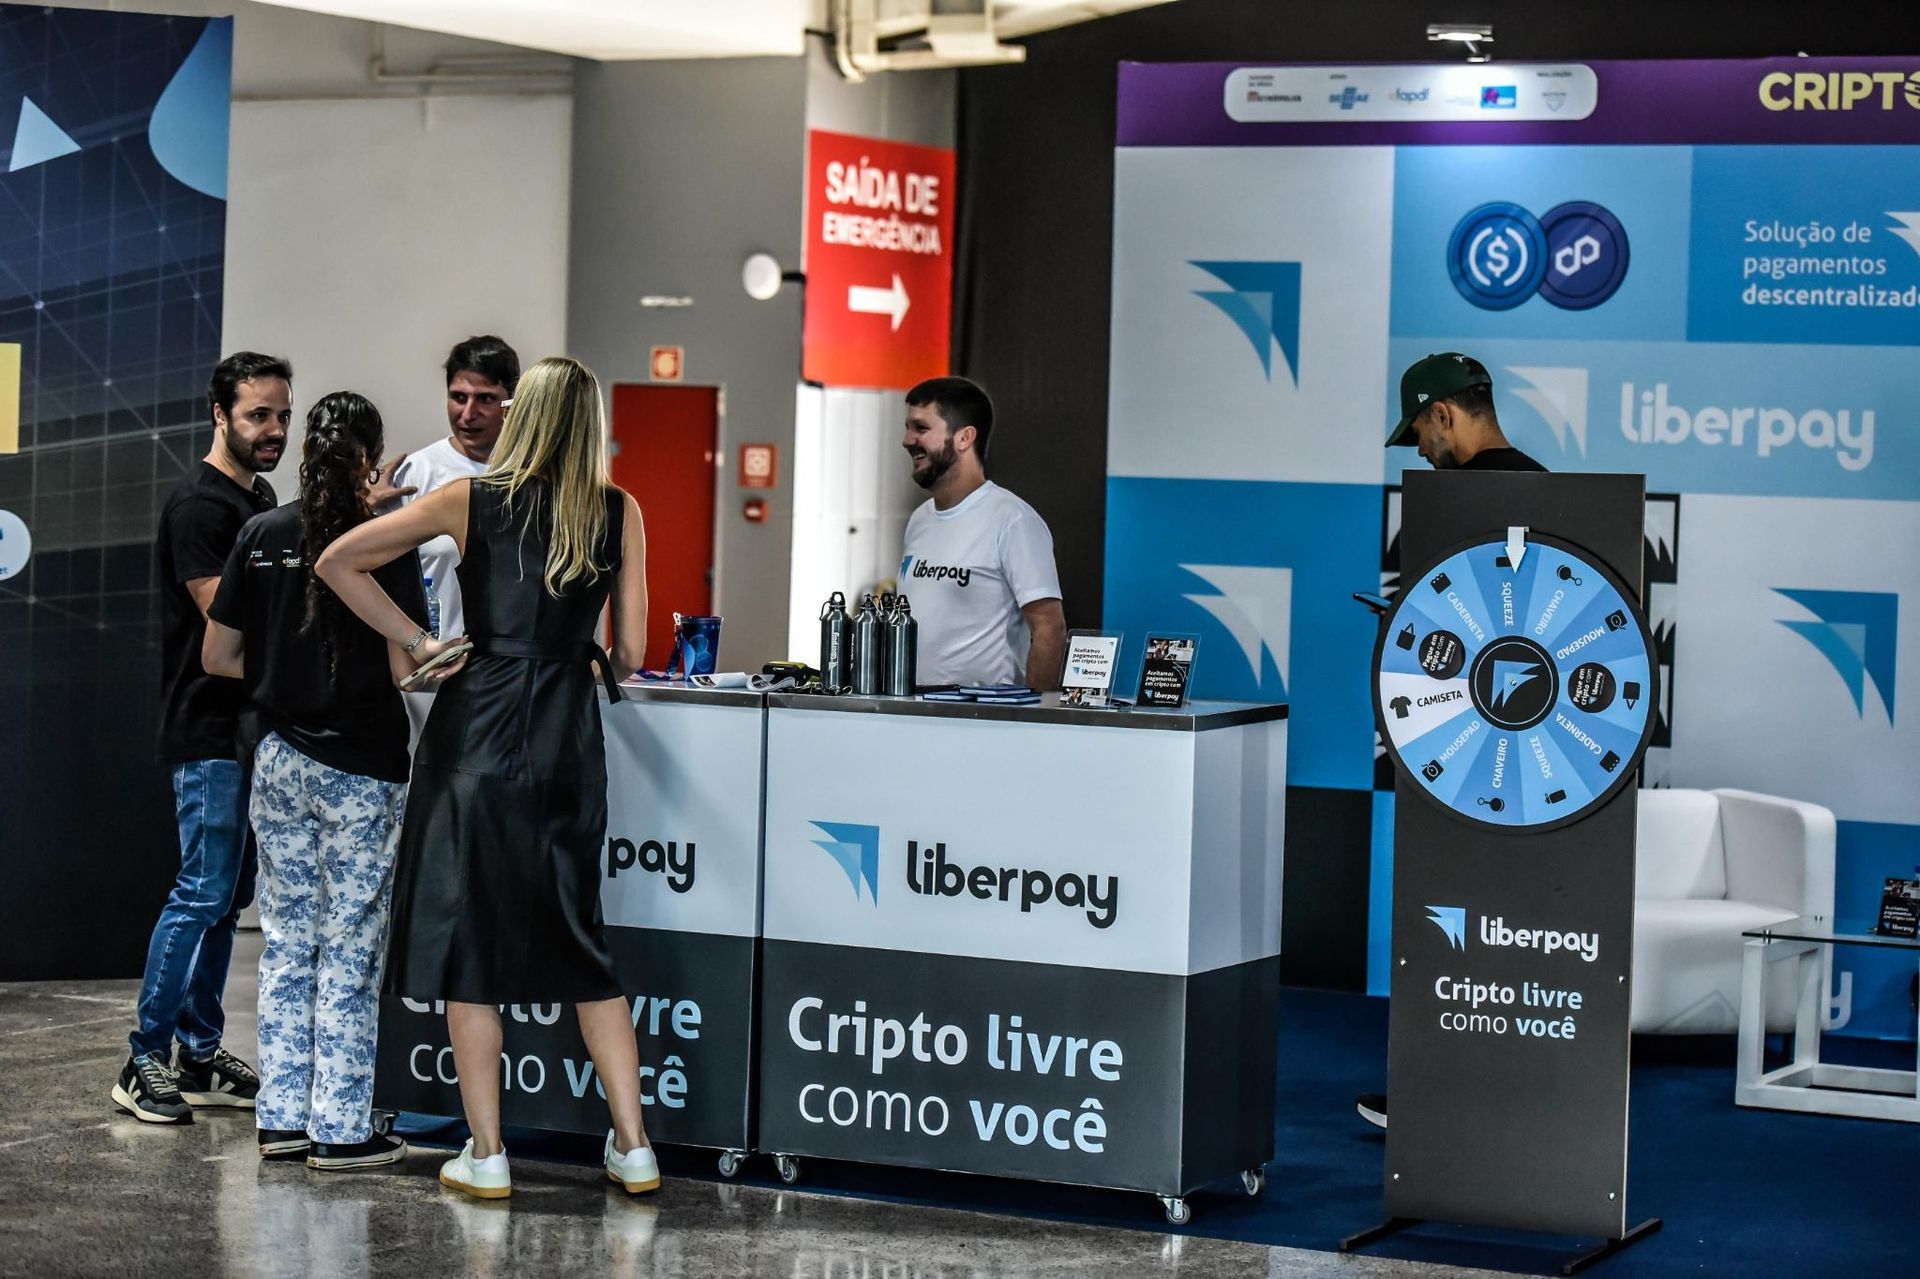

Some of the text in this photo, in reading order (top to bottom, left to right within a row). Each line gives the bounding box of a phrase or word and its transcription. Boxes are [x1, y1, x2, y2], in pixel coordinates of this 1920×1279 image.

[825, 155, 939, 216] SAÍDA DE
[822, 211, 942, 255] EMERGÊNCIA
[1744, 220, 1871, 248] Solução de
[1743, 256, 1887, 280] pagamentos
[1620, 382, 1875, 471] liberpay
[912, 559, 971, 587] liberpay
[1447, 591, 1485, 643] CADERNETA
[1503, 582, 1514, 627] SQUEEZE
[1535, 590, 1564, 636] CHAVEIRO
[1556, 626, 1605, 660] MOUSEPAD
[1417, 690, 1463, 708] CAMISETA
[1439, 720, 1481, 763] MOUSEPAD
[1555, 712, 1602, 755] CADERNETA
[1492, 738, 1508, 789] CHAVEIRO
[1530, 735, 1553, 779] SQUEEZE
[906, 840, 1119, 929] liberpay
[1480, 915, 1599, 962] liberpay
[1435, 976, 1583, 1010] Cripto livre
[788, 997, 968, 1075] Cripto
[988, 1014, 1123, 1081] livre
[1440, 1012, 1576, 1040] como você
[563, 1055, 688, 1108] vcê
[799, 1083, 1107, 1153] como você
